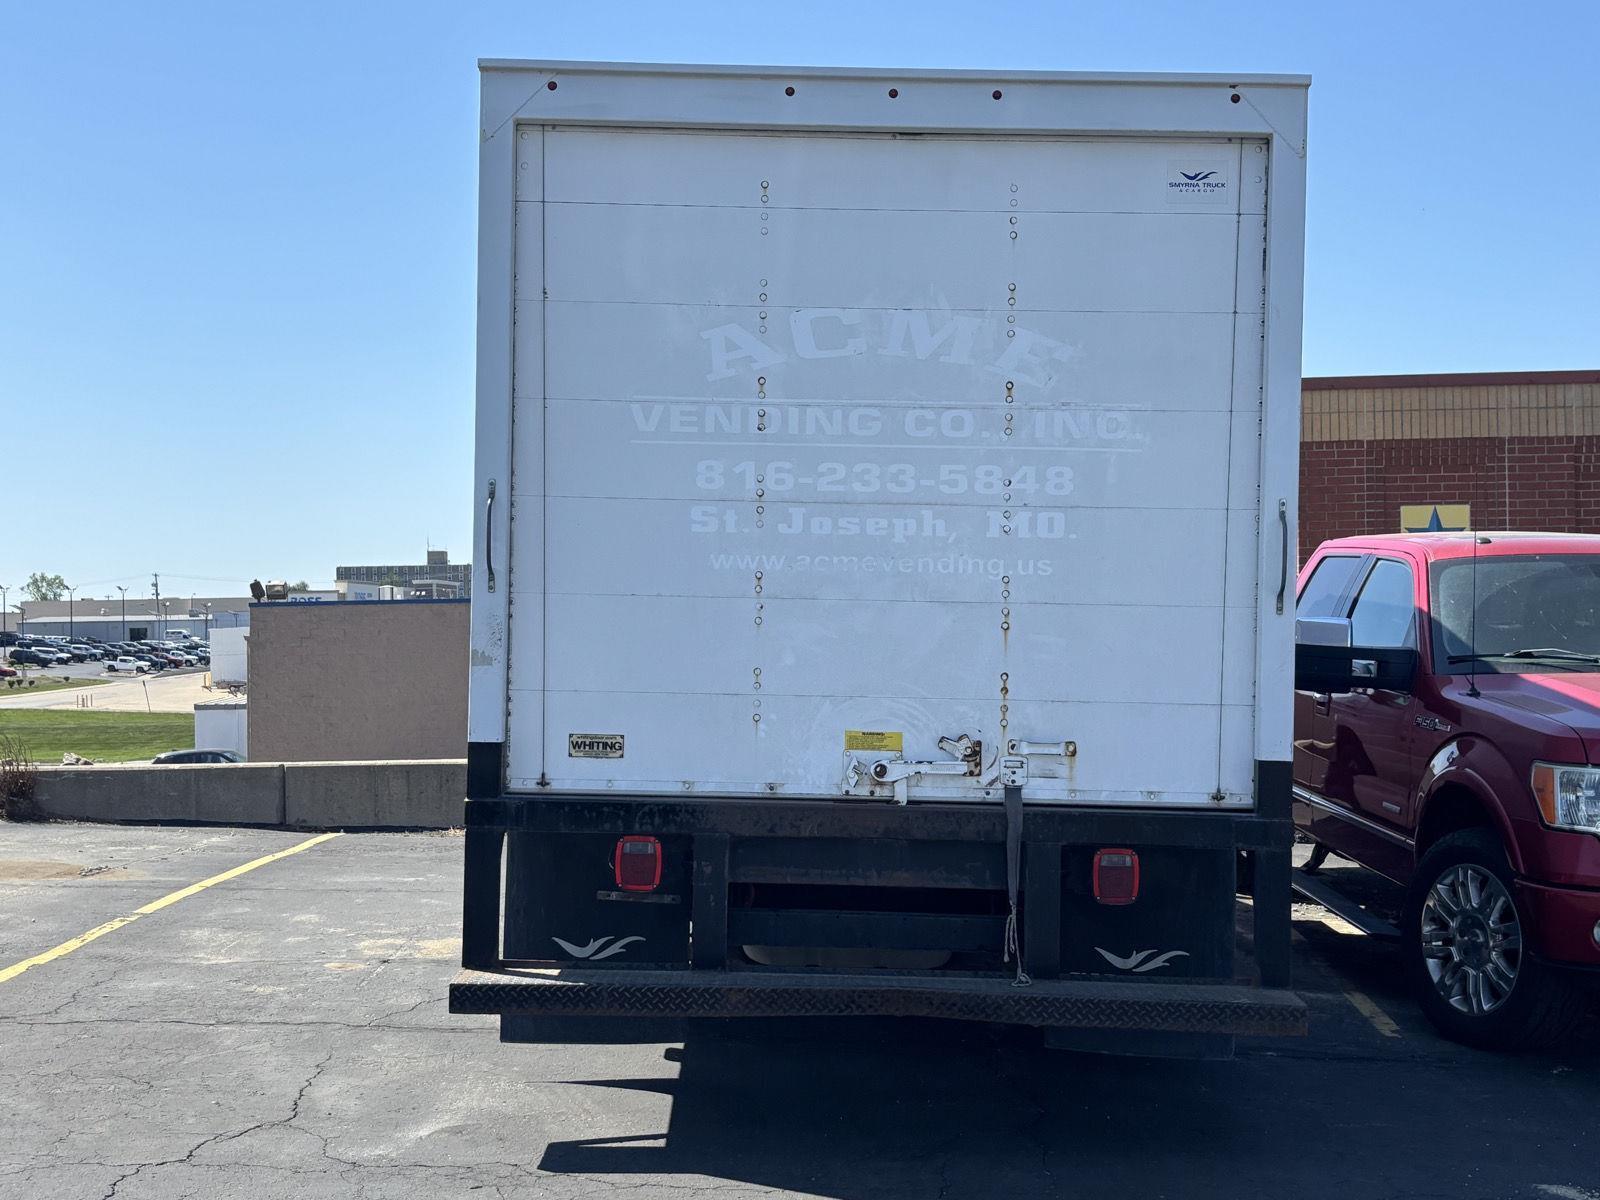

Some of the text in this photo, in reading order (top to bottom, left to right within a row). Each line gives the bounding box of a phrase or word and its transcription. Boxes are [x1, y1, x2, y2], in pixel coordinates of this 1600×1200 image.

[700, 308, 1074, 392] ACME
[631, 404, 882, 436] VENDING
[1033, 410, 1145, 440] INC.
[695, 460, 1075, 496] 816-233-5848
[690, 506, 1078, 543] St. Joseph, MO.
[709, 551, 1054, 577] www.acmevending.us
[571, 740, 622, 751] WHITING
